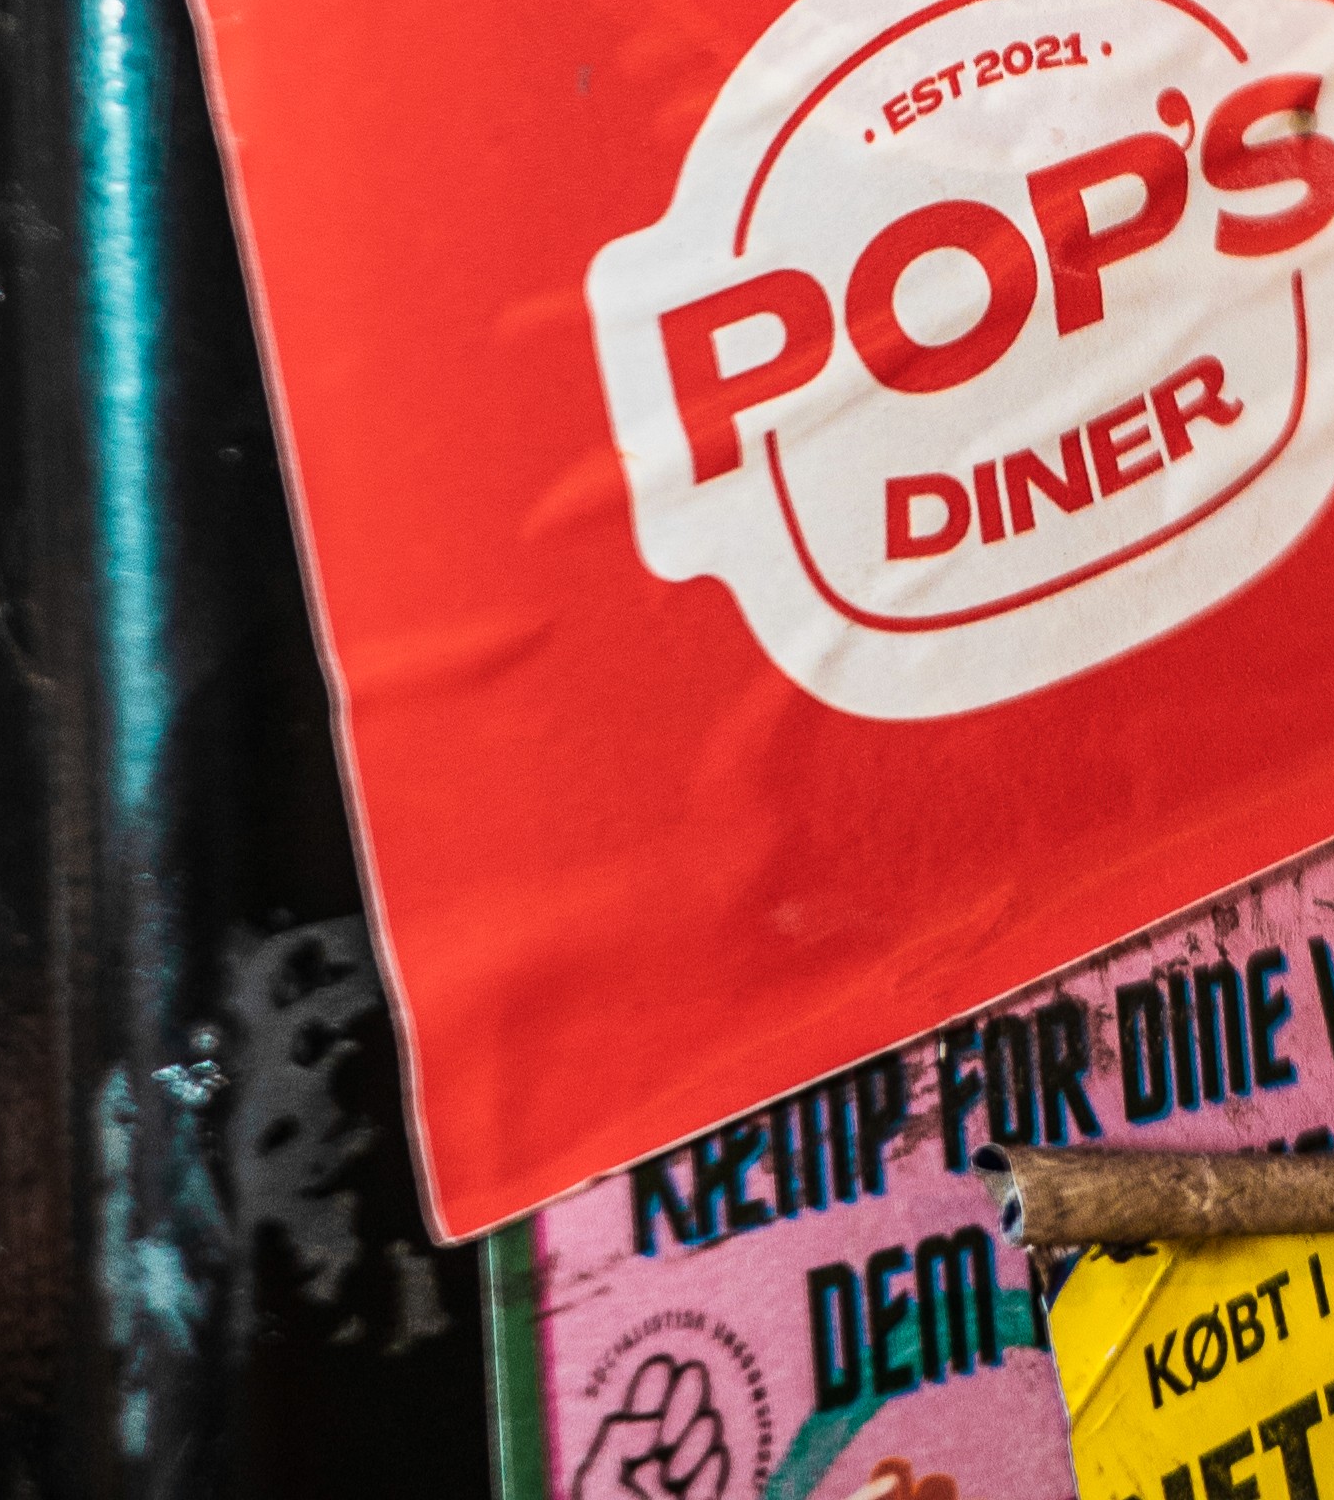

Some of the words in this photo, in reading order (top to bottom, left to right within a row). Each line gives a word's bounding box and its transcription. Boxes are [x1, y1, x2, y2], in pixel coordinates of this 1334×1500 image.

[881, 60, 966, 136] EST
[972, 31, 1089, 88] 2021
[885, 355, 1244, 561] DINER
[938, 995, 1102, 1175] FOR
[1115, 946, 1299, 1127] DINE
[806, 1222, 1005, 1416] DEM
[1143, 1269, 1291, 1410] KØBT
[1308, 1252, 1330, 1319] I
